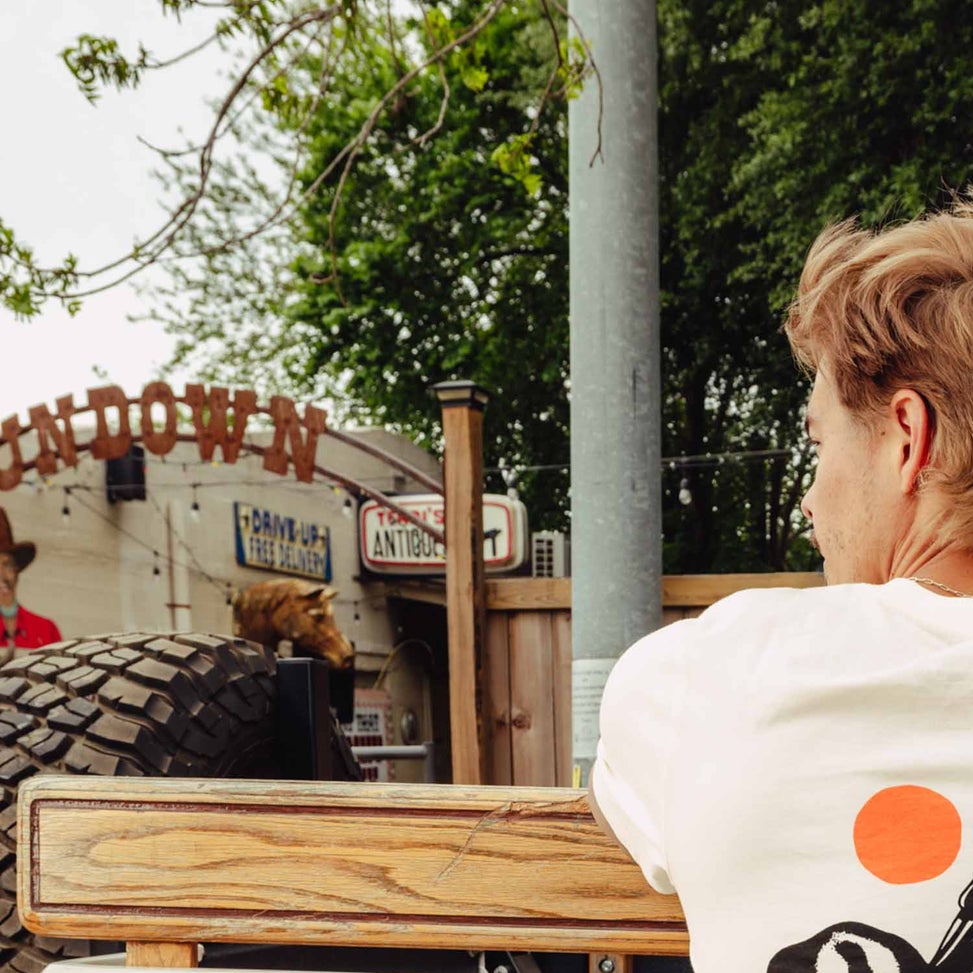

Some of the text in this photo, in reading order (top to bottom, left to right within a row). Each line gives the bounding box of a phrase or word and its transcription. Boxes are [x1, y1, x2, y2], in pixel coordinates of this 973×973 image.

[252, 507, 318, 547] DRIVE-UP
[249, 536, 325, 575] FREE DELIVERY
